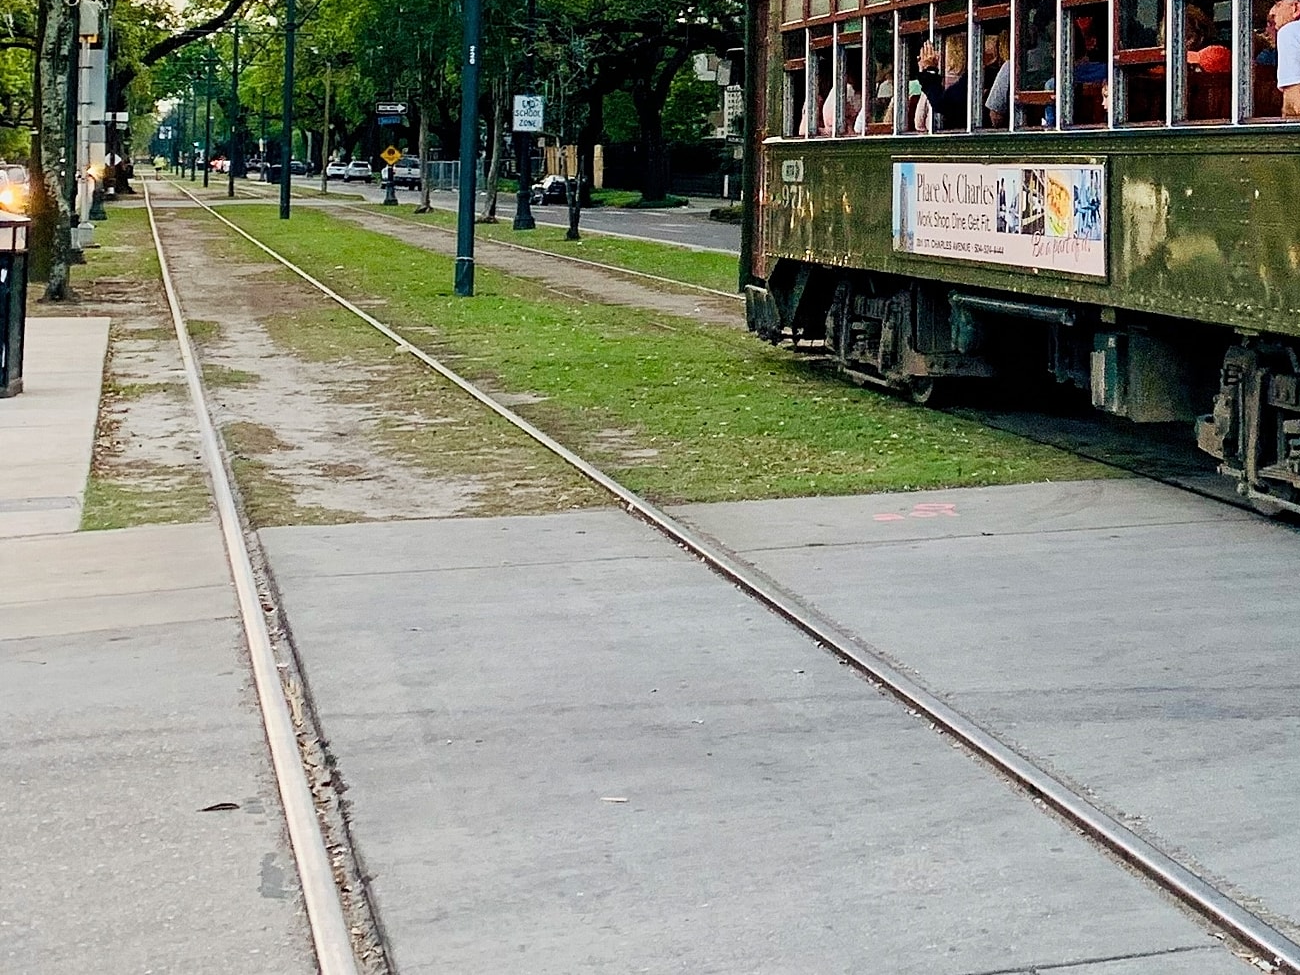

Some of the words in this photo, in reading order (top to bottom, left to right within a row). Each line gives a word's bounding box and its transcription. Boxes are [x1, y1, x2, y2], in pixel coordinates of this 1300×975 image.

[514, 109, 541, 117] SCHOOL
[518, 119, 537, 127] ZONE
[917, 173, 940, 203] Place
[942, 173, 955, 204] St.
[957, 173, 995, 205] Charles
